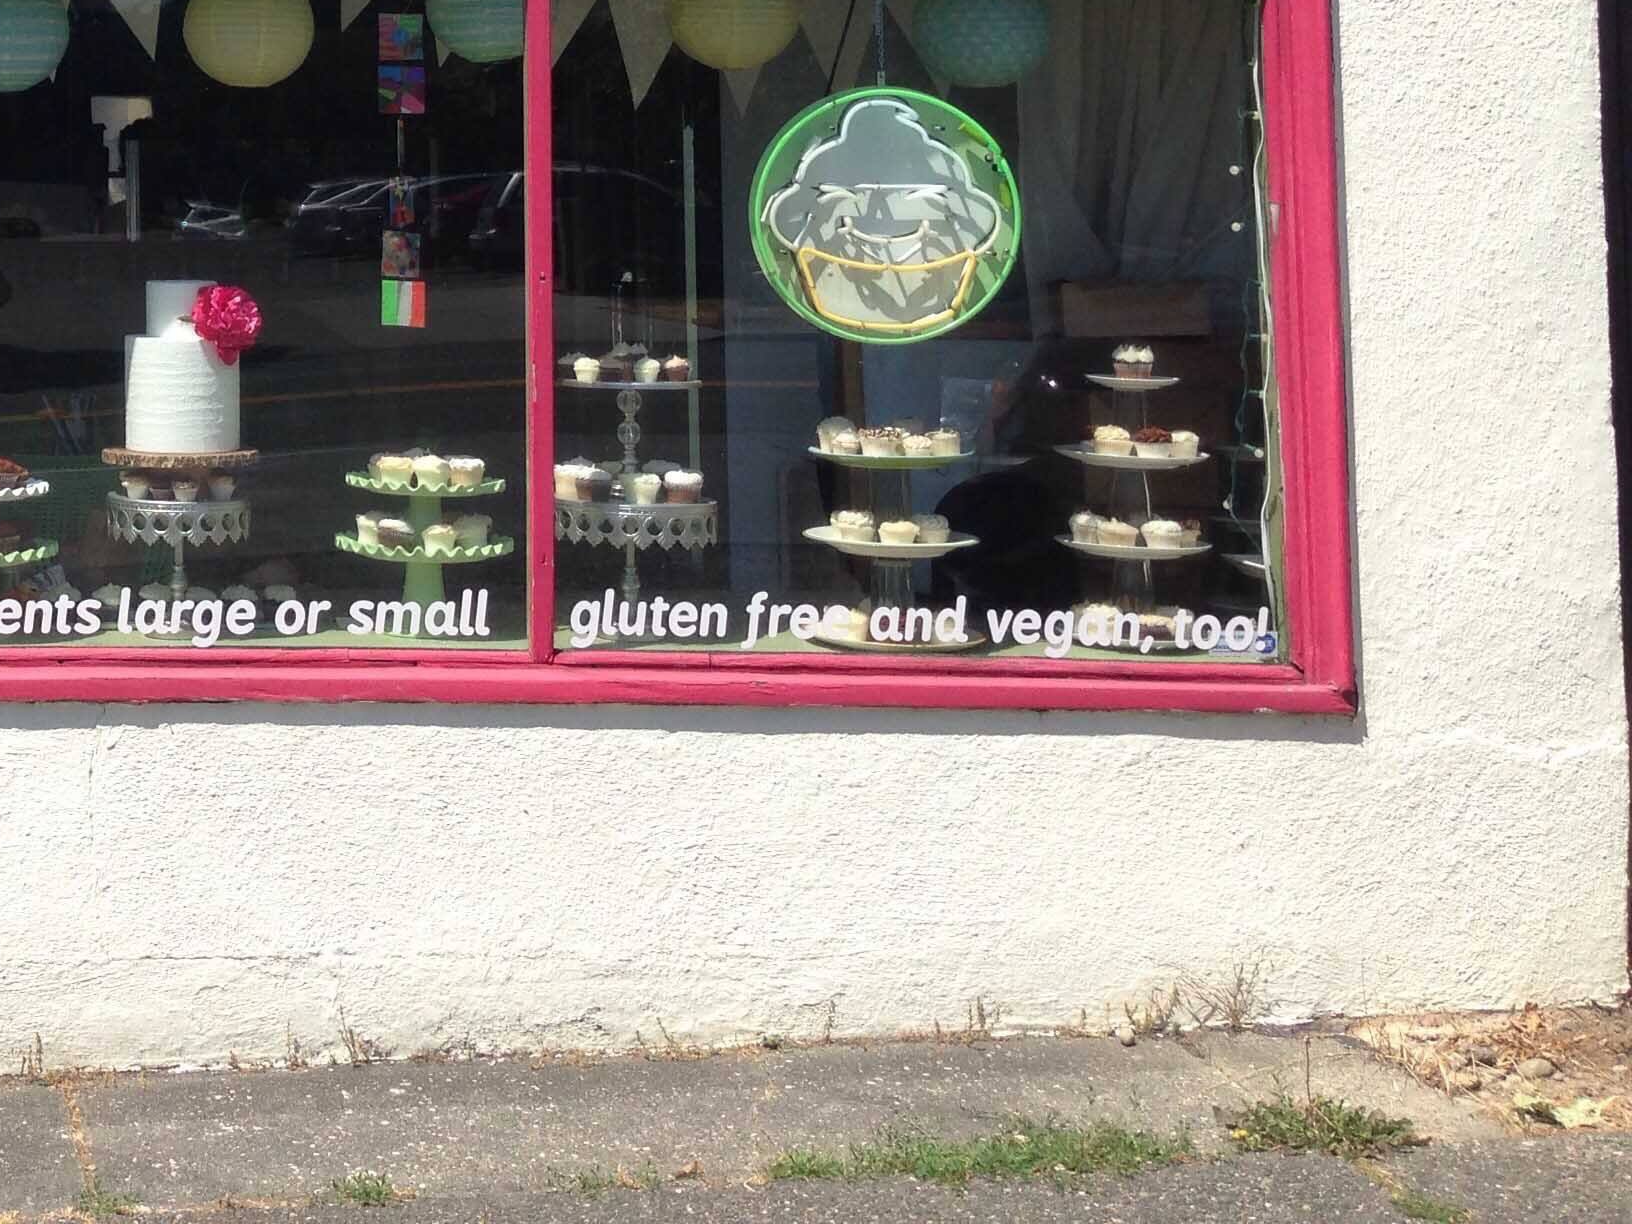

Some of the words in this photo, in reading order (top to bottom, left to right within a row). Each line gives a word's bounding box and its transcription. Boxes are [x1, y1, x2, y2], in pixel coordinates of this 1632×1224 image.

[117, 587, 256, 648] large
[275, 599, 328, 635] or
[347, 588, 491, 637] small
[570, 589, 728, 649] gluten
[741, 591, 852, 649] free
[869, 595, 968, 644] and
[986, 604, 1155, 659] vegan,
[1175, 606, 1269, 651] too!
